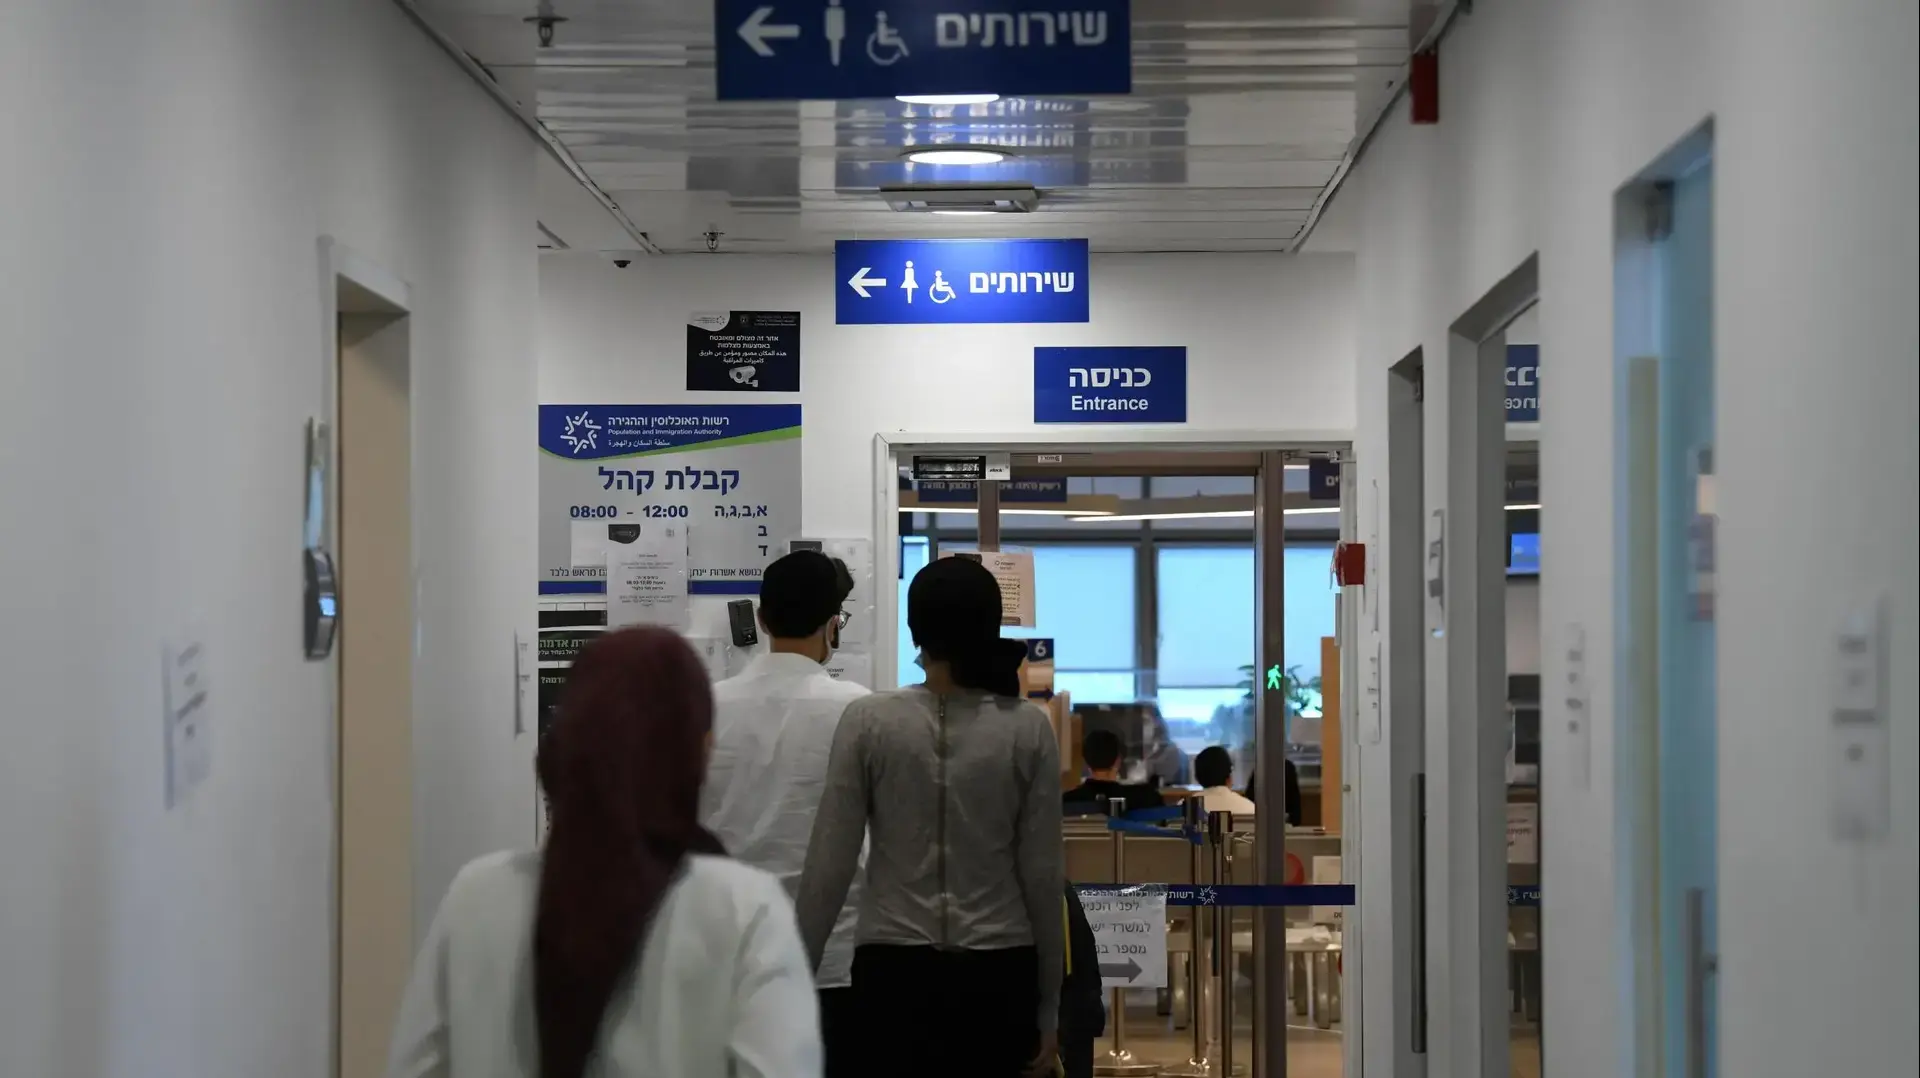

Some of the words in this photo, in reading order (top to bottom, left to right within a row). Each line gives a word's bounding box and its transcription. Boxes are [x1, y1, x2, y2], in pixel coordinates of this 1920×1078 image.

[936, 11, 1108, 47] שירותים
[969, 271, 1075, 294] שירותים
[1069, 366, 1152, 389] כניסה
[1071, 395, 1149, 411] Entrance
[608, 416, 648, 426] וההגירה
[651, 415, 700, 428] האוכלוסין
[702, 416, 730, 426] רשות
[608, 428, 641, 436] Population
[655, 428, 693, 436] Immigration
[694, 428, 722, 436] Authority
[598, 466, 655, 496] קהל
[665, 466, 740, 496] קבלת
[569, 505, 618, 518] 08:00
[642, 504, 689, 518] 12:00
[757, 524, 768, 537] ב
[758, 544, 768, 557] ד
[572, 568, 596, 577] מראש
[1034, 640, 1047, 657] 6
[1168, 890, 1194, 900] רשות
[1115, 898, 1140, 912] לפני
[1111, 920, 1151, 933] למשרד
[1111, 943, 1147, 954] מספר
